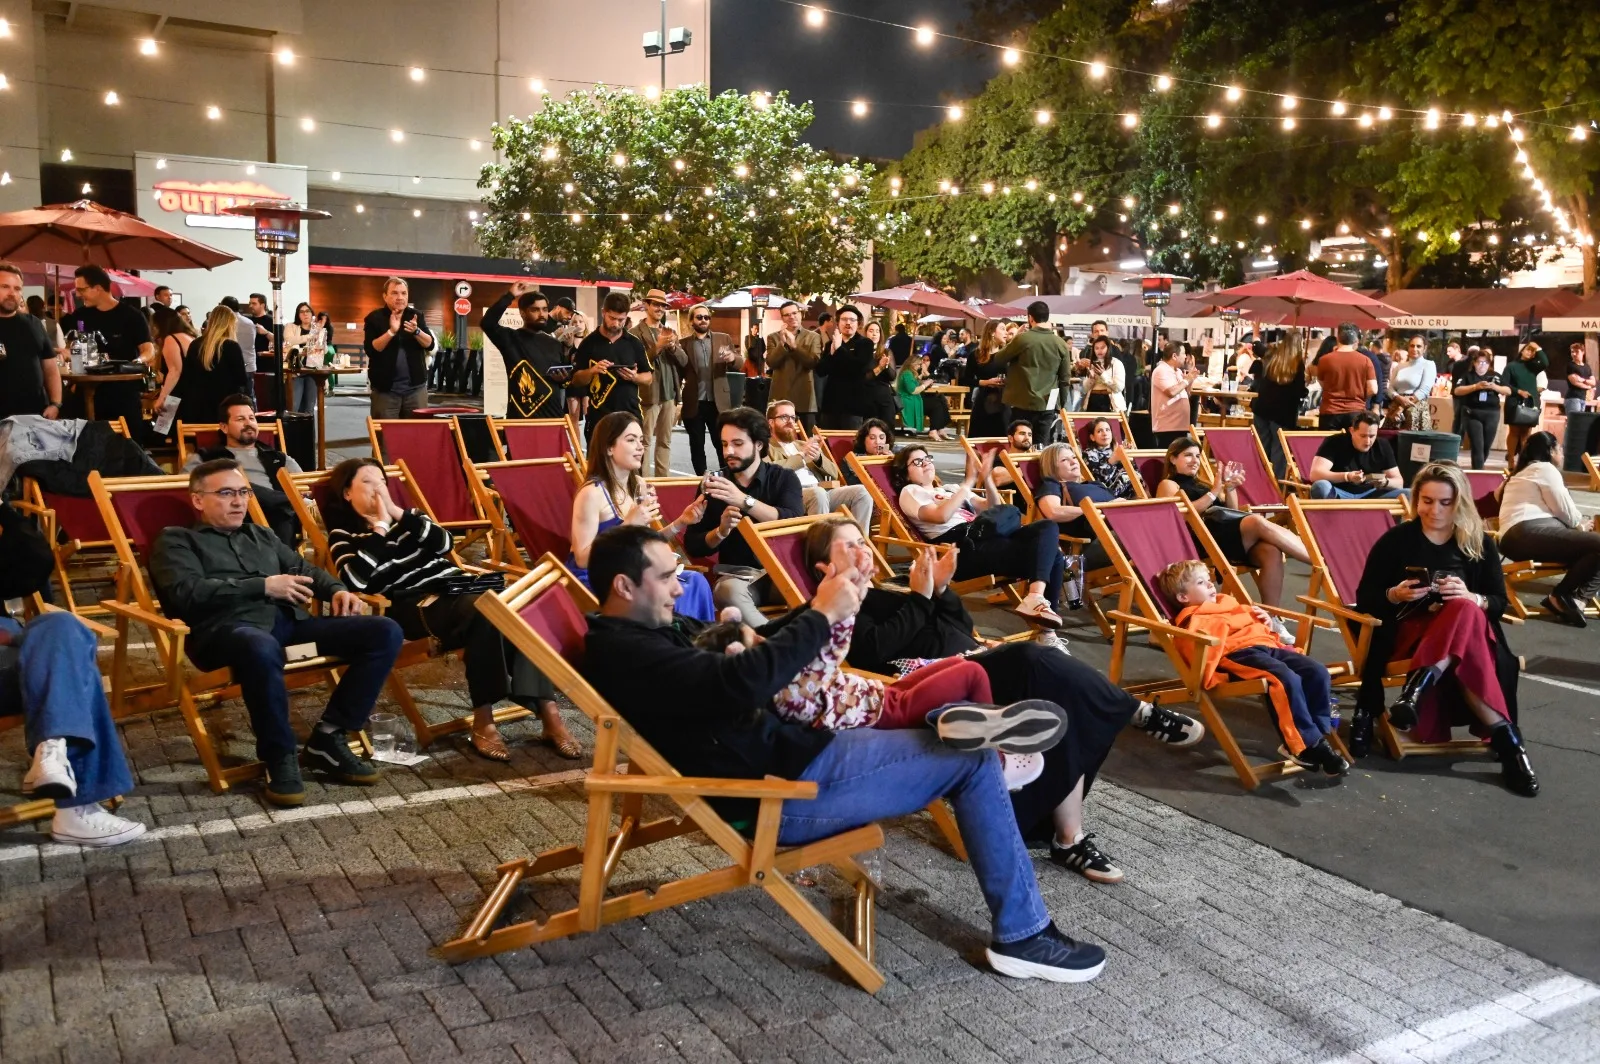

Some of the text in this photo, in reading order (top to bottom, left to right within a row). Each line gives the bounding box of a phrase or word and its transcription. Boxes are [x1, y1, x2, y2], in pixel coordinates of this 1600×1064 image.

[1389, 318, 1449, 327] GRAND CRU
[1581, 320, 1600, 329] MA
